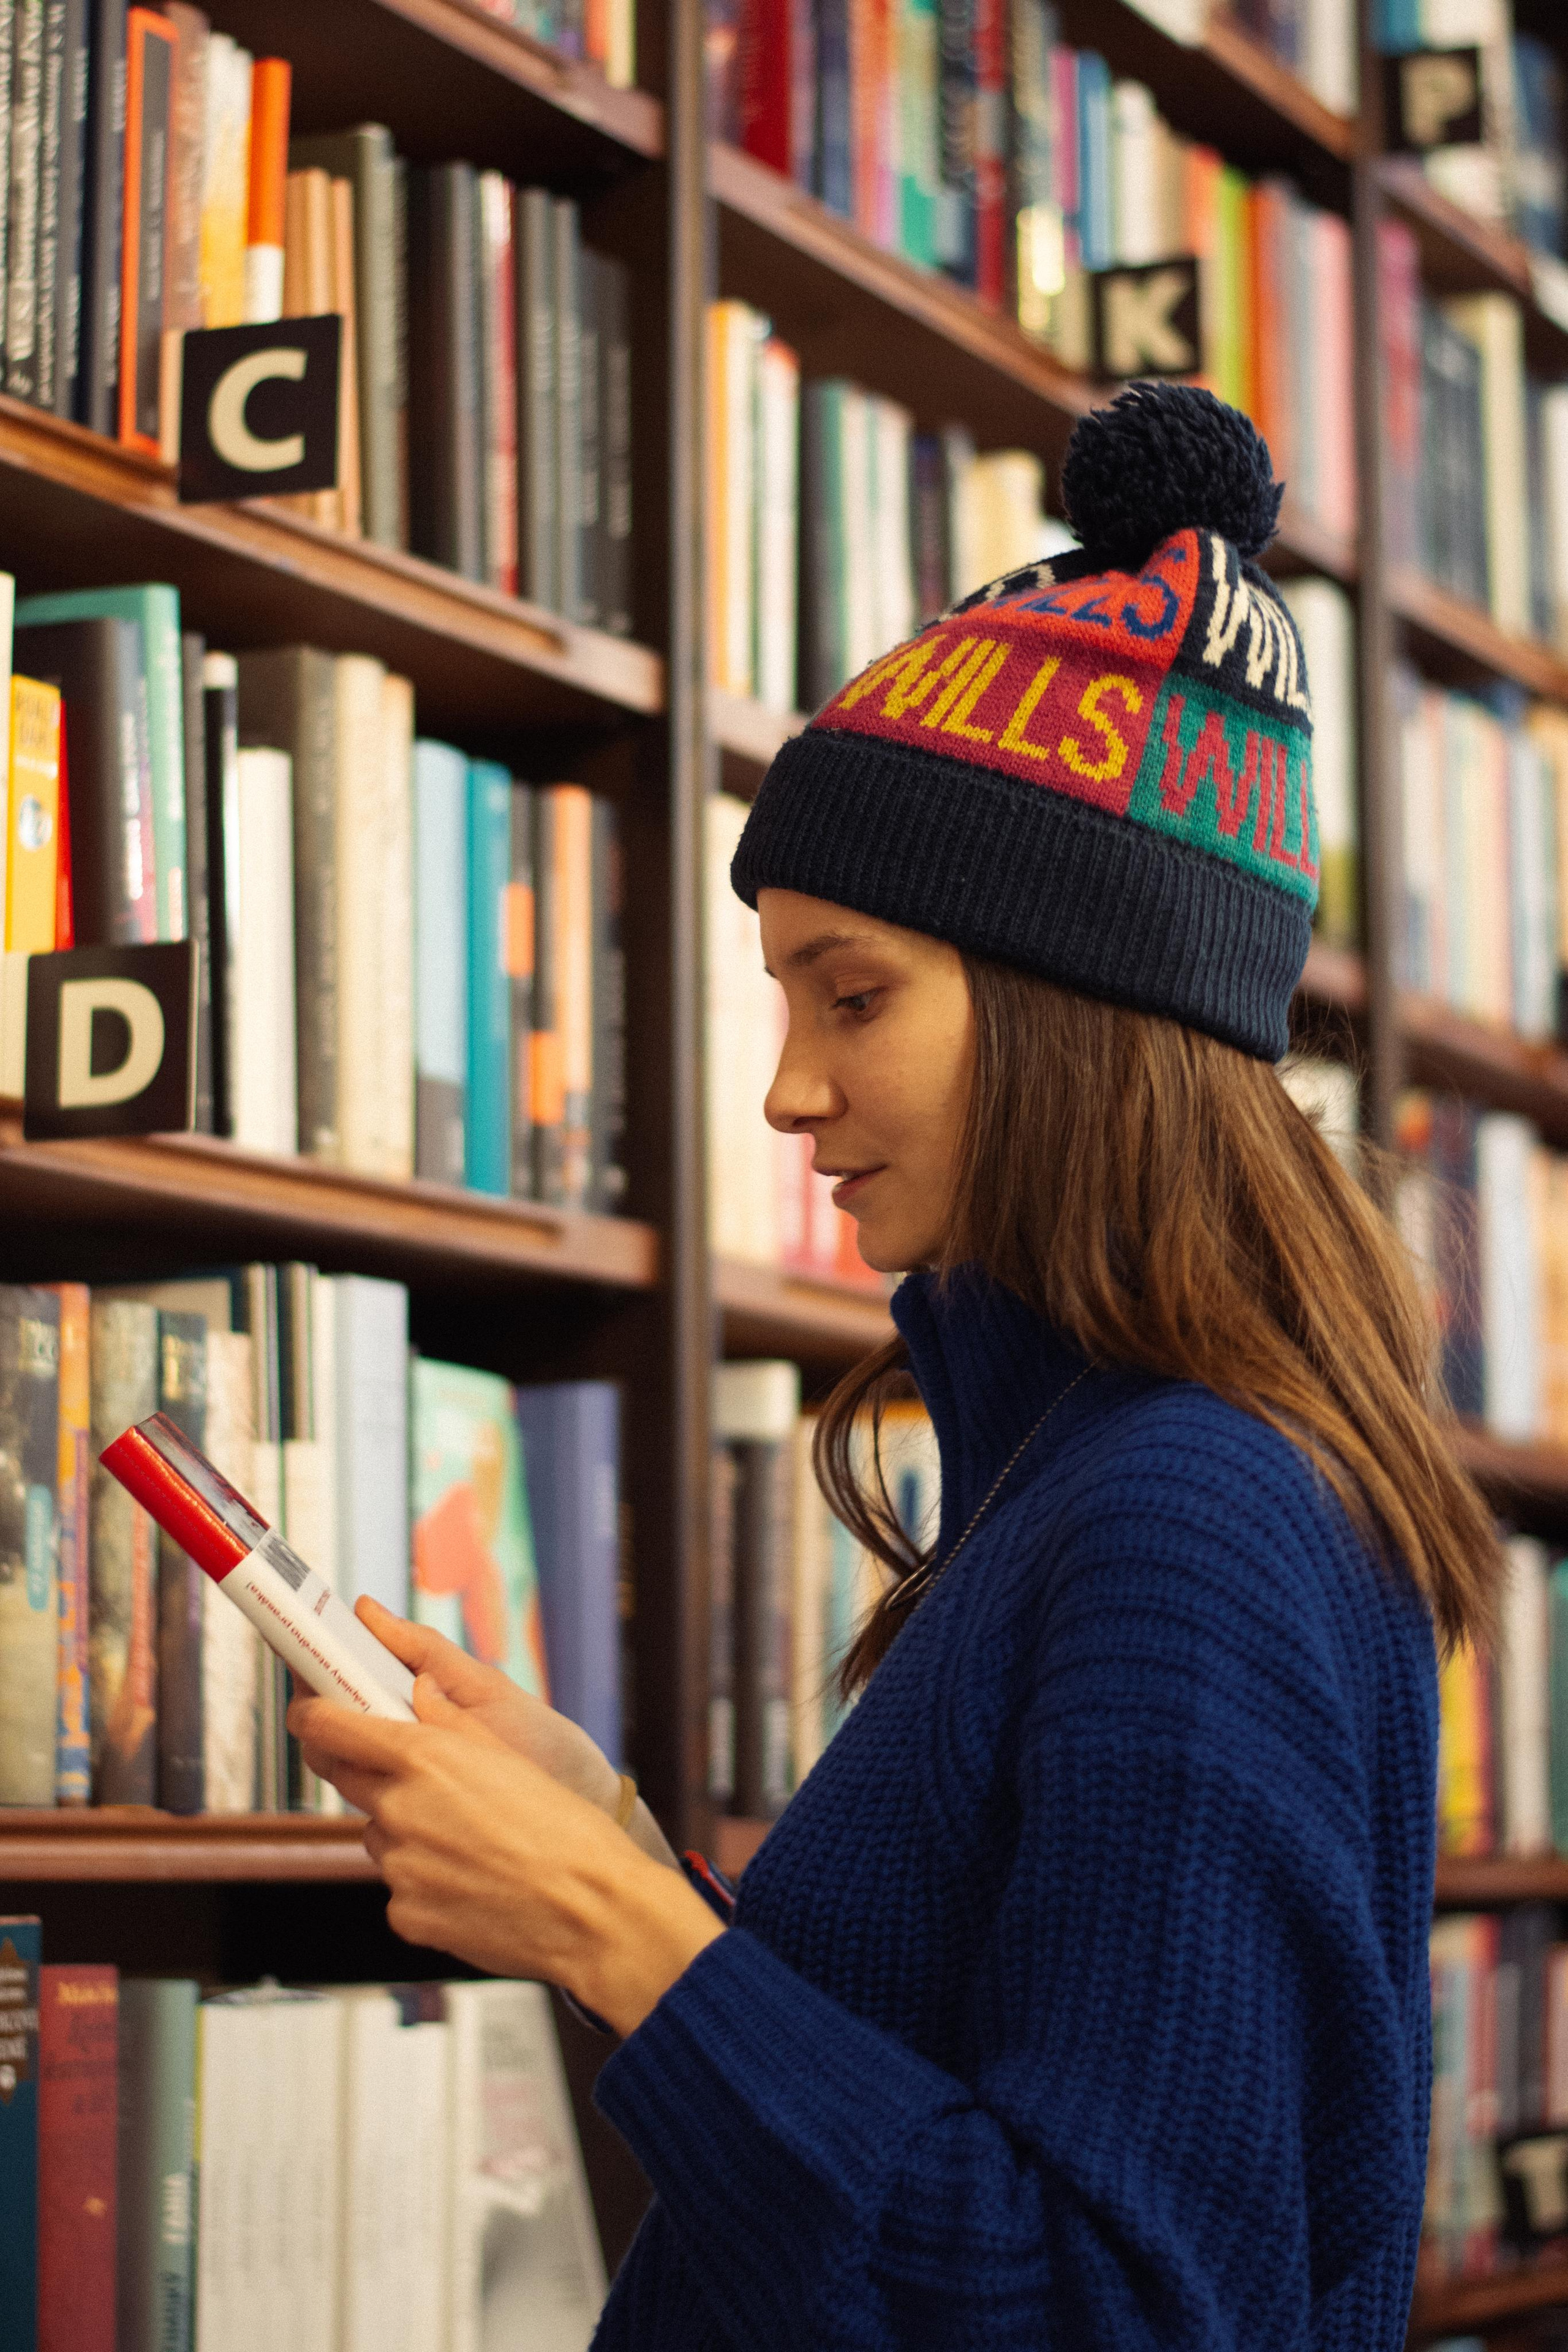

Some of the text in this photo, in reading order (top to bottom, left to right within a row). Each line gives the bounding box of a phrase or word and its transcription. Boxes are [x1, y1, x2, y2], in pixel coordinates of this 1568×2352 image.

[1405, 58, 1472, 142] P
[1105, 276, 1191, 369] K
[209, 346, 309, 473] C
[837, 635, 1144, 782] WILLS
[58, 978, 165, 1110] D
